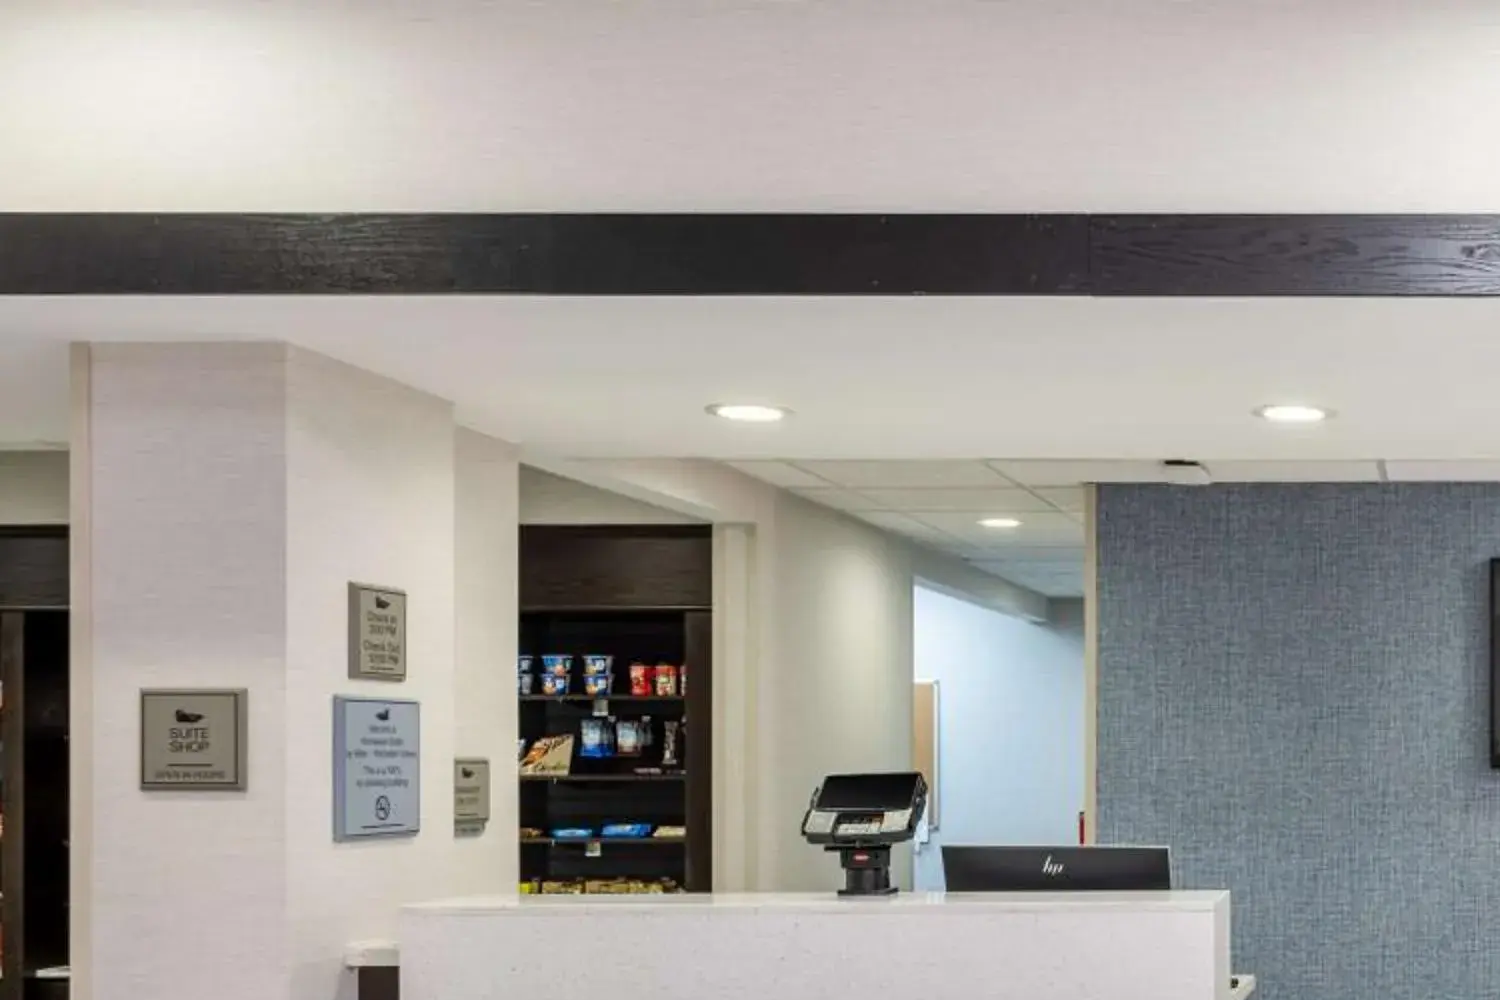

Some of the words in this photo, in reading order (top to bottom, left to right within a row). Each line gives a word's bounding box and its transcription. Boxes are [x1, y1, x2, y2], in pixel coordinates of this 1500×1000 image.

[169, 727, 209, 739] SUITE
[168, 740, 210, 752] SHOP
[1042, 853, 1065, 876] hp
